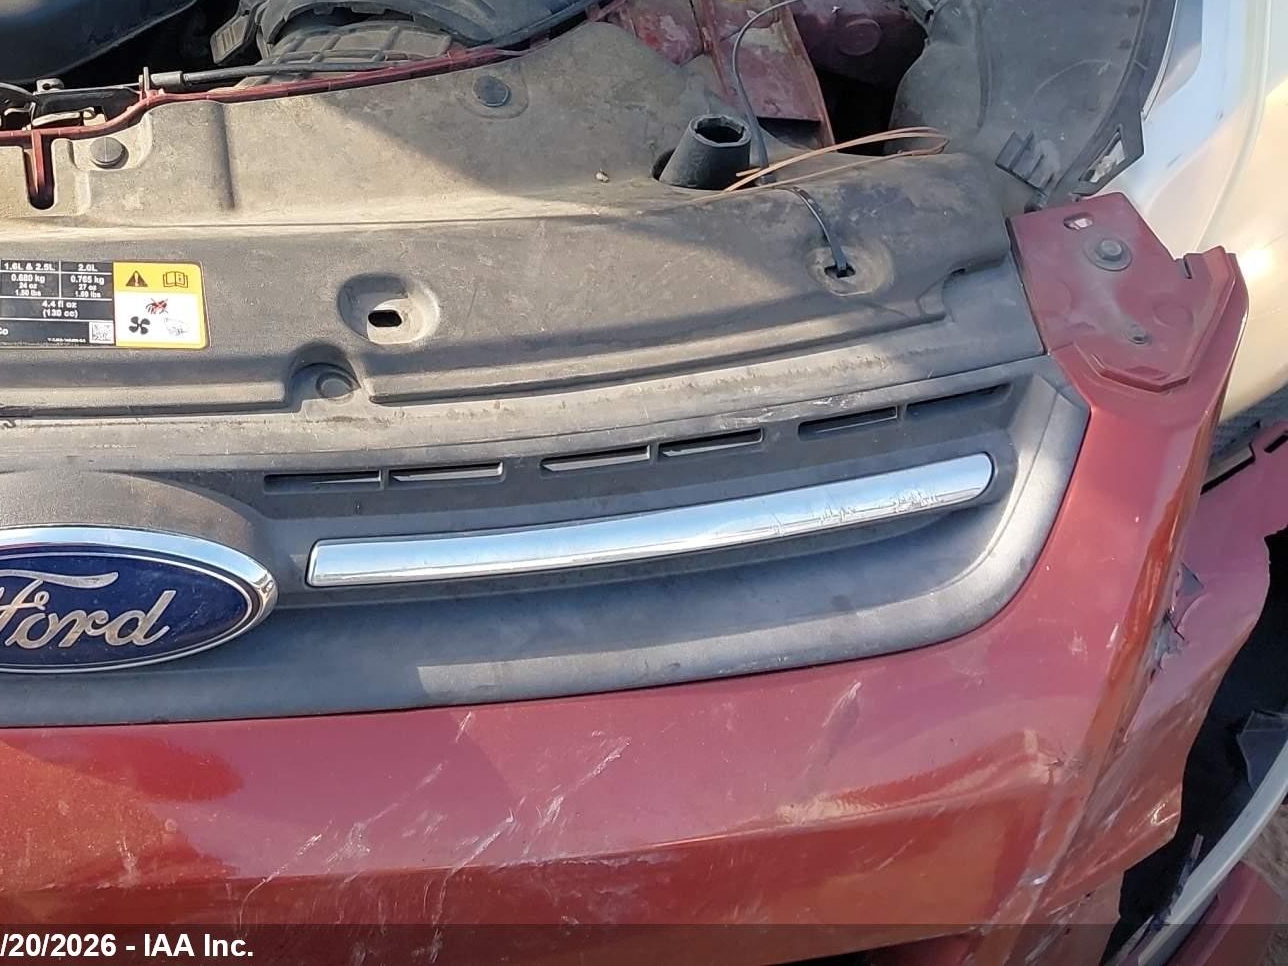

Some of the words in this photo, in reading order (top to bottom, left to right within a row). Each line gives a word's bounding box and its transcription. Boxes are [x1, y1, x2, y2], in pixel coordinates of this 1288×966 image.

[35, 263, 55, 271] 2.5L
[78, 264, 98, 272] 2.0L
[34, 274, 46, 283] kg
[94, 276, 105, 285] kg
[42, 300, 56, 308] 4.4
[57, 300, 64, 308] fl
[42, 310, 62, 318] (130
[64, 310, 78, 318] cc)
